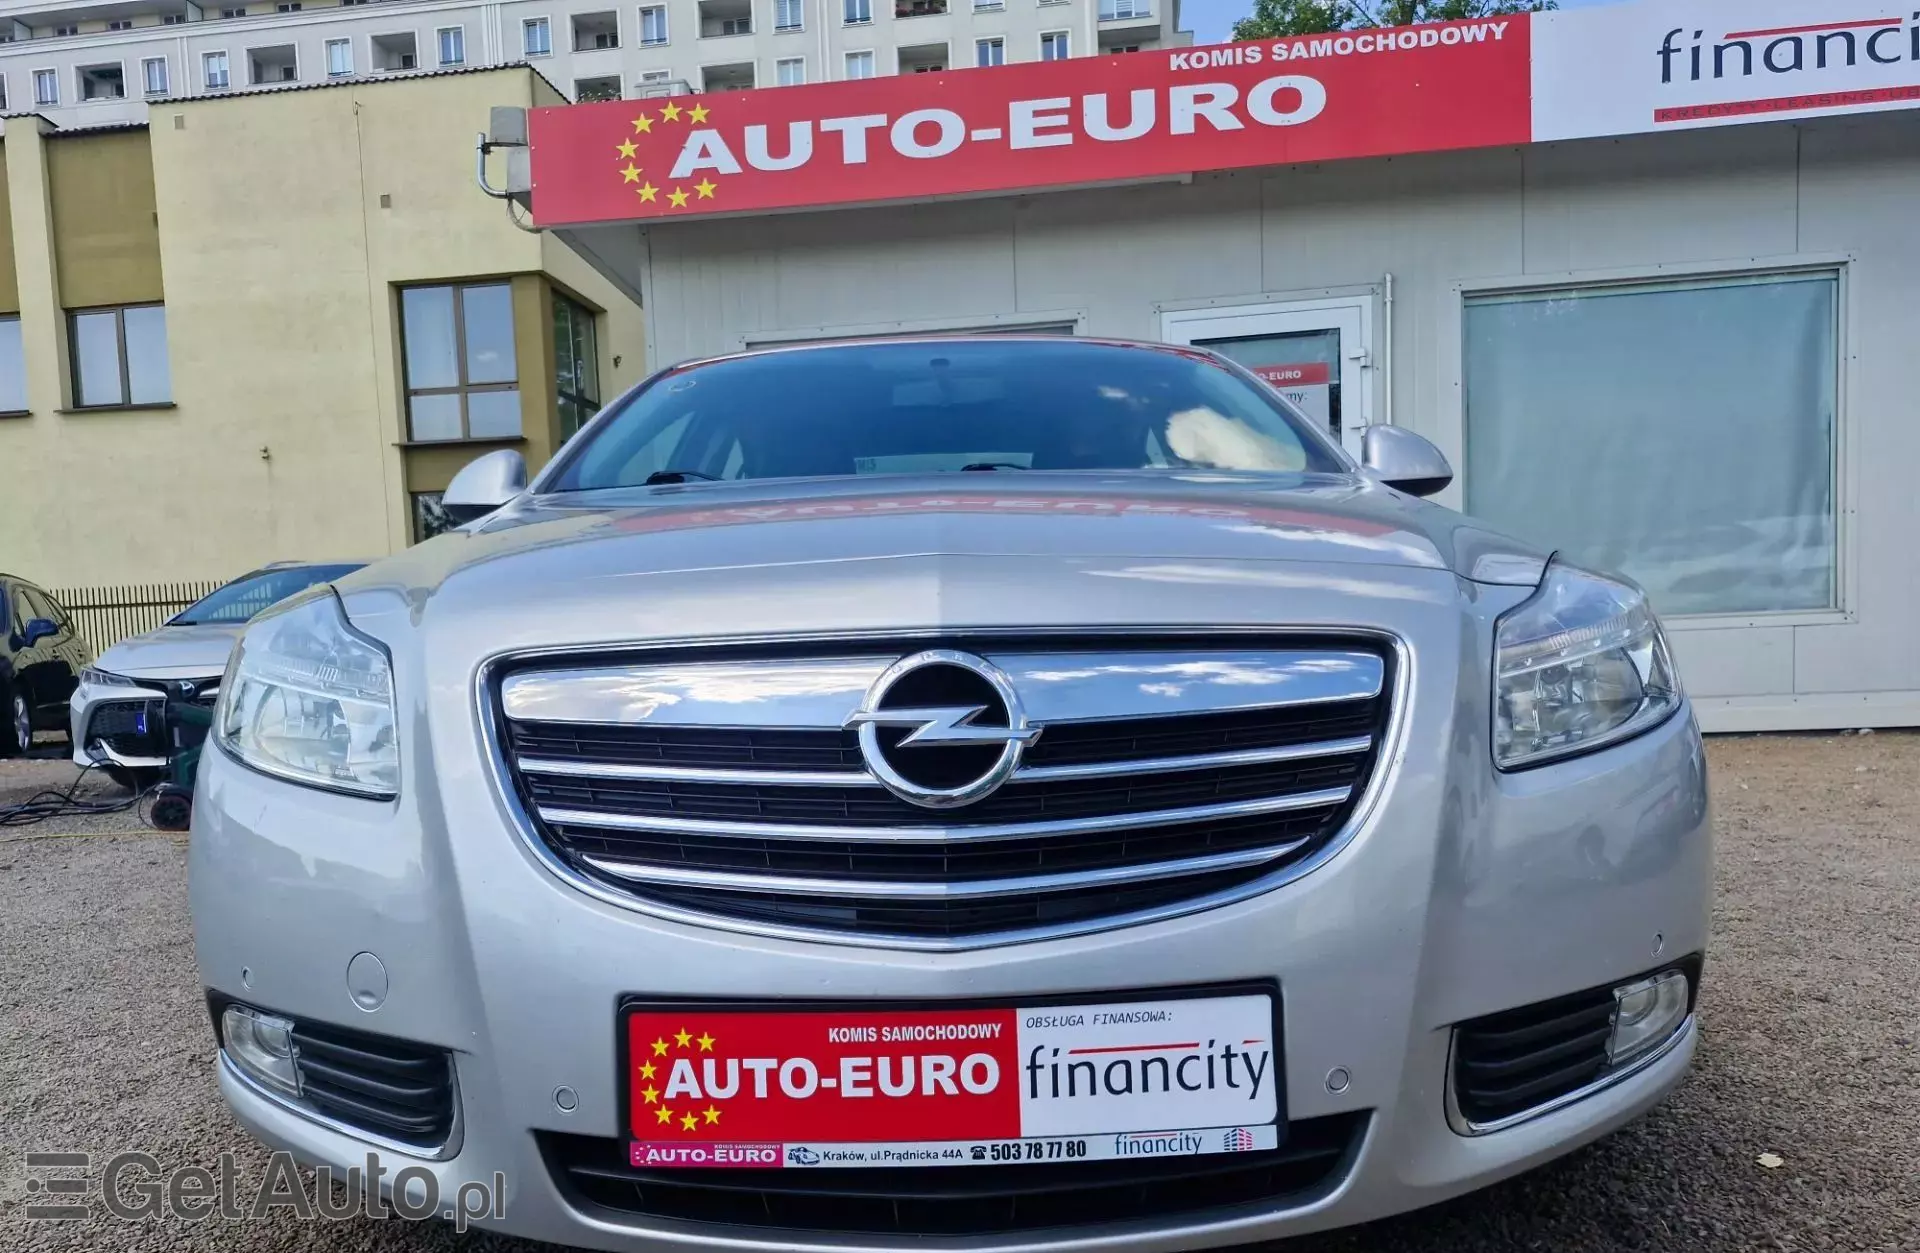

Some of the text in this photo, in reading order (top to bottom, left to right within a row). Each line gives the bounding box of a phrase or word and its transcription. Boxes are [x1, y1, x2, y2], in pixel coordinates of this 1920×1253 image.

[1169, 21, 1509, 71] KOMIS SAMOCHODOWY
[668, 74, 1327, 179] AUTO-EURO
[1026, 1010, 1172, 1028] OBSŁUGA FINANSOWA:
[828, 1023, 1002, 1043] KOMIS SAMOCHODOWY
[663, 1053, 1000, 1100] AUTO-EURO
[1026, 1039, 1269, 1100] financity
[646, 1148, 777, 1162] AUTO-EURO
[823, 1149, 868, 1162] Kraków,
[942, 1148, 963, 1160] 44A
[990, 1140, 1086, 1161] 503 78 77 80
[1114, 1132, 1203, 1156] financity
